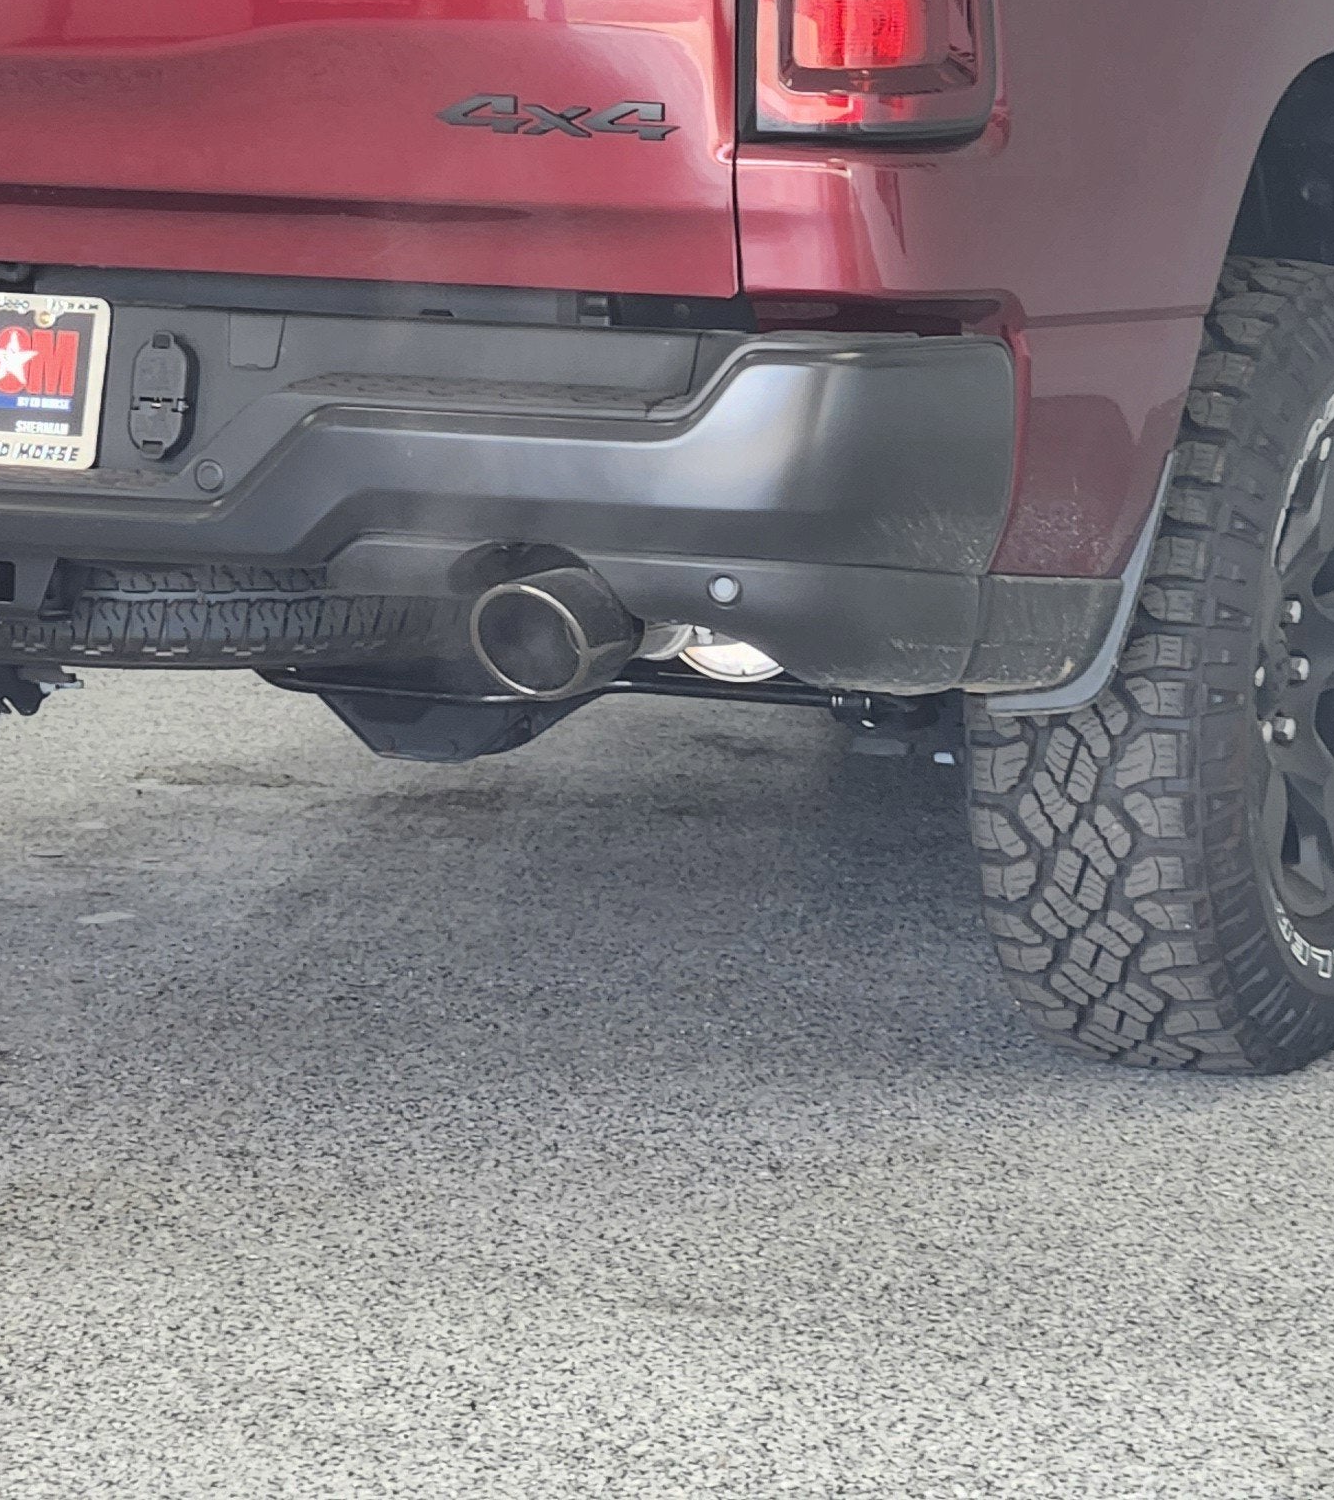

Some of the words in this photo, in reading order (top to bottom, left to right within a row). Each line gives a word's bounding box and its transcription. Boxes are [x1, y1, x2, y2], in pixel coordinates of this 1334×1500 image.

[436, 93, 681, 141] 4x4
[15, 419, 69, 435] SHERMAN
[16, 443, 80, 461] MORSE
